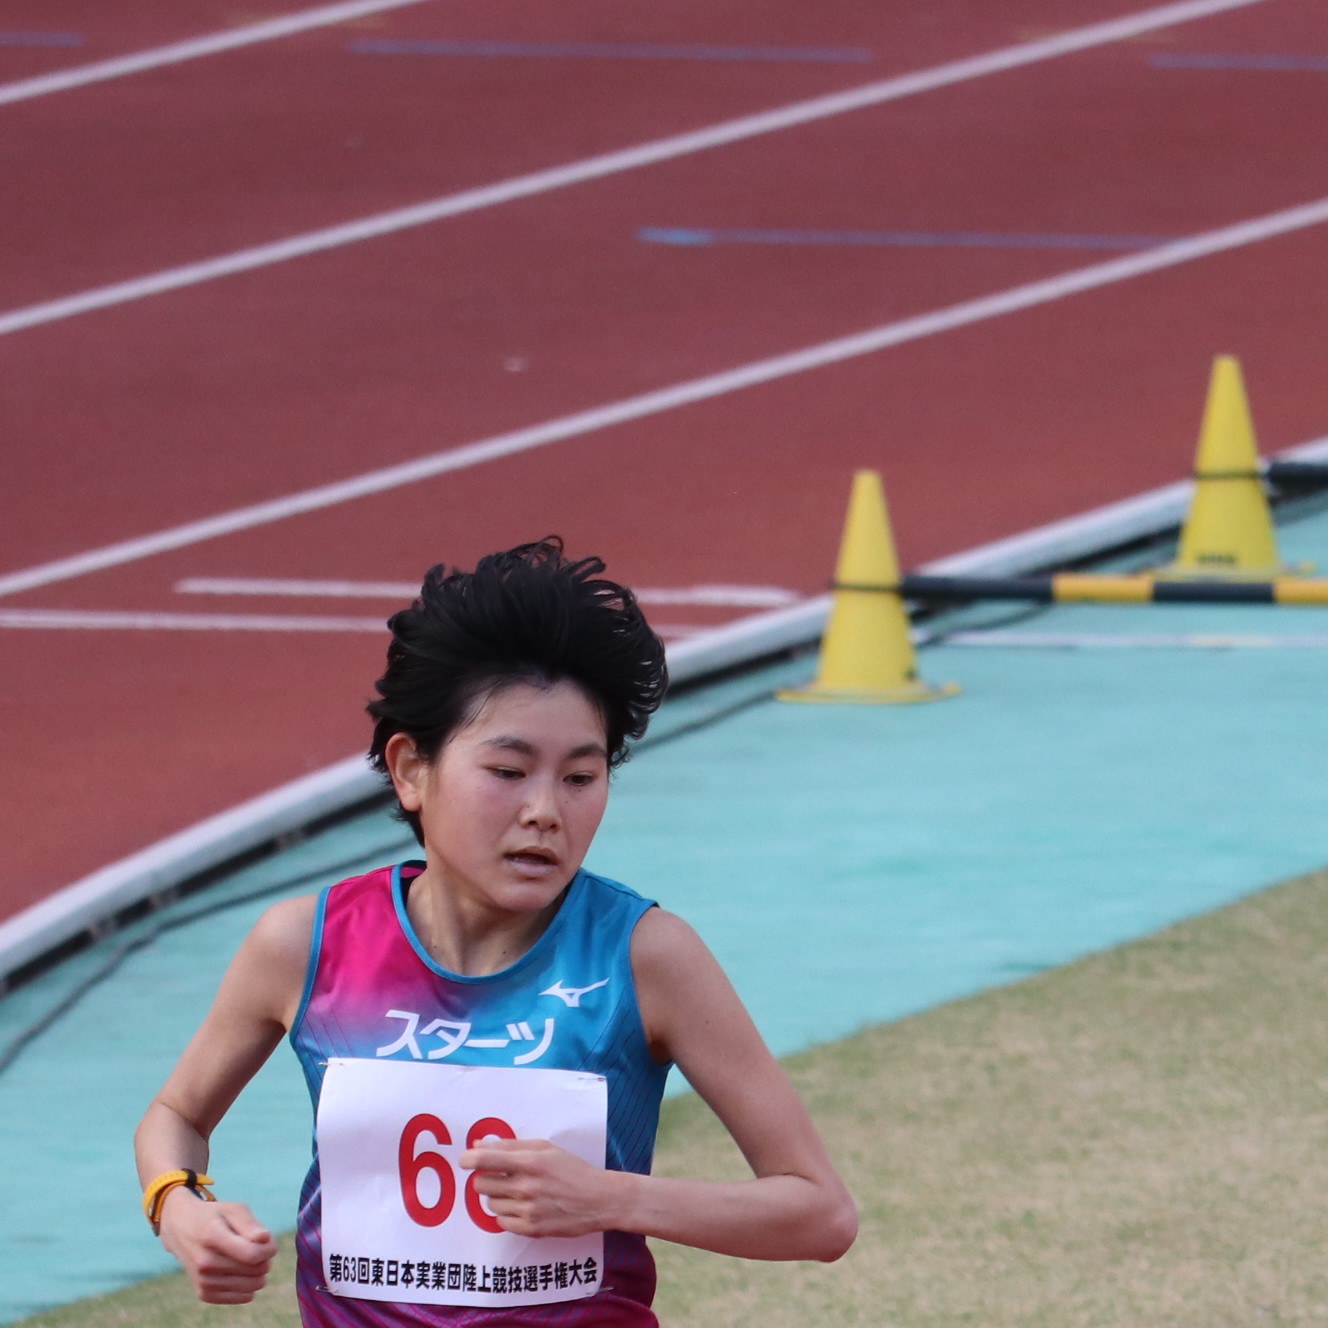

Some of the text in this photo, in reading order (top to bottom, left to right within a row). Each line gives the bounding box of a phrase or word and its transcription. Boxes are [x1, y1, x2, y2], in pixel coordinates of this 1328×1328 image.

[376, 1009, 555, 1065] スターツ
[329, 1253, 598, 1294] 第63回東日本実業団陸上競技選手権大会
